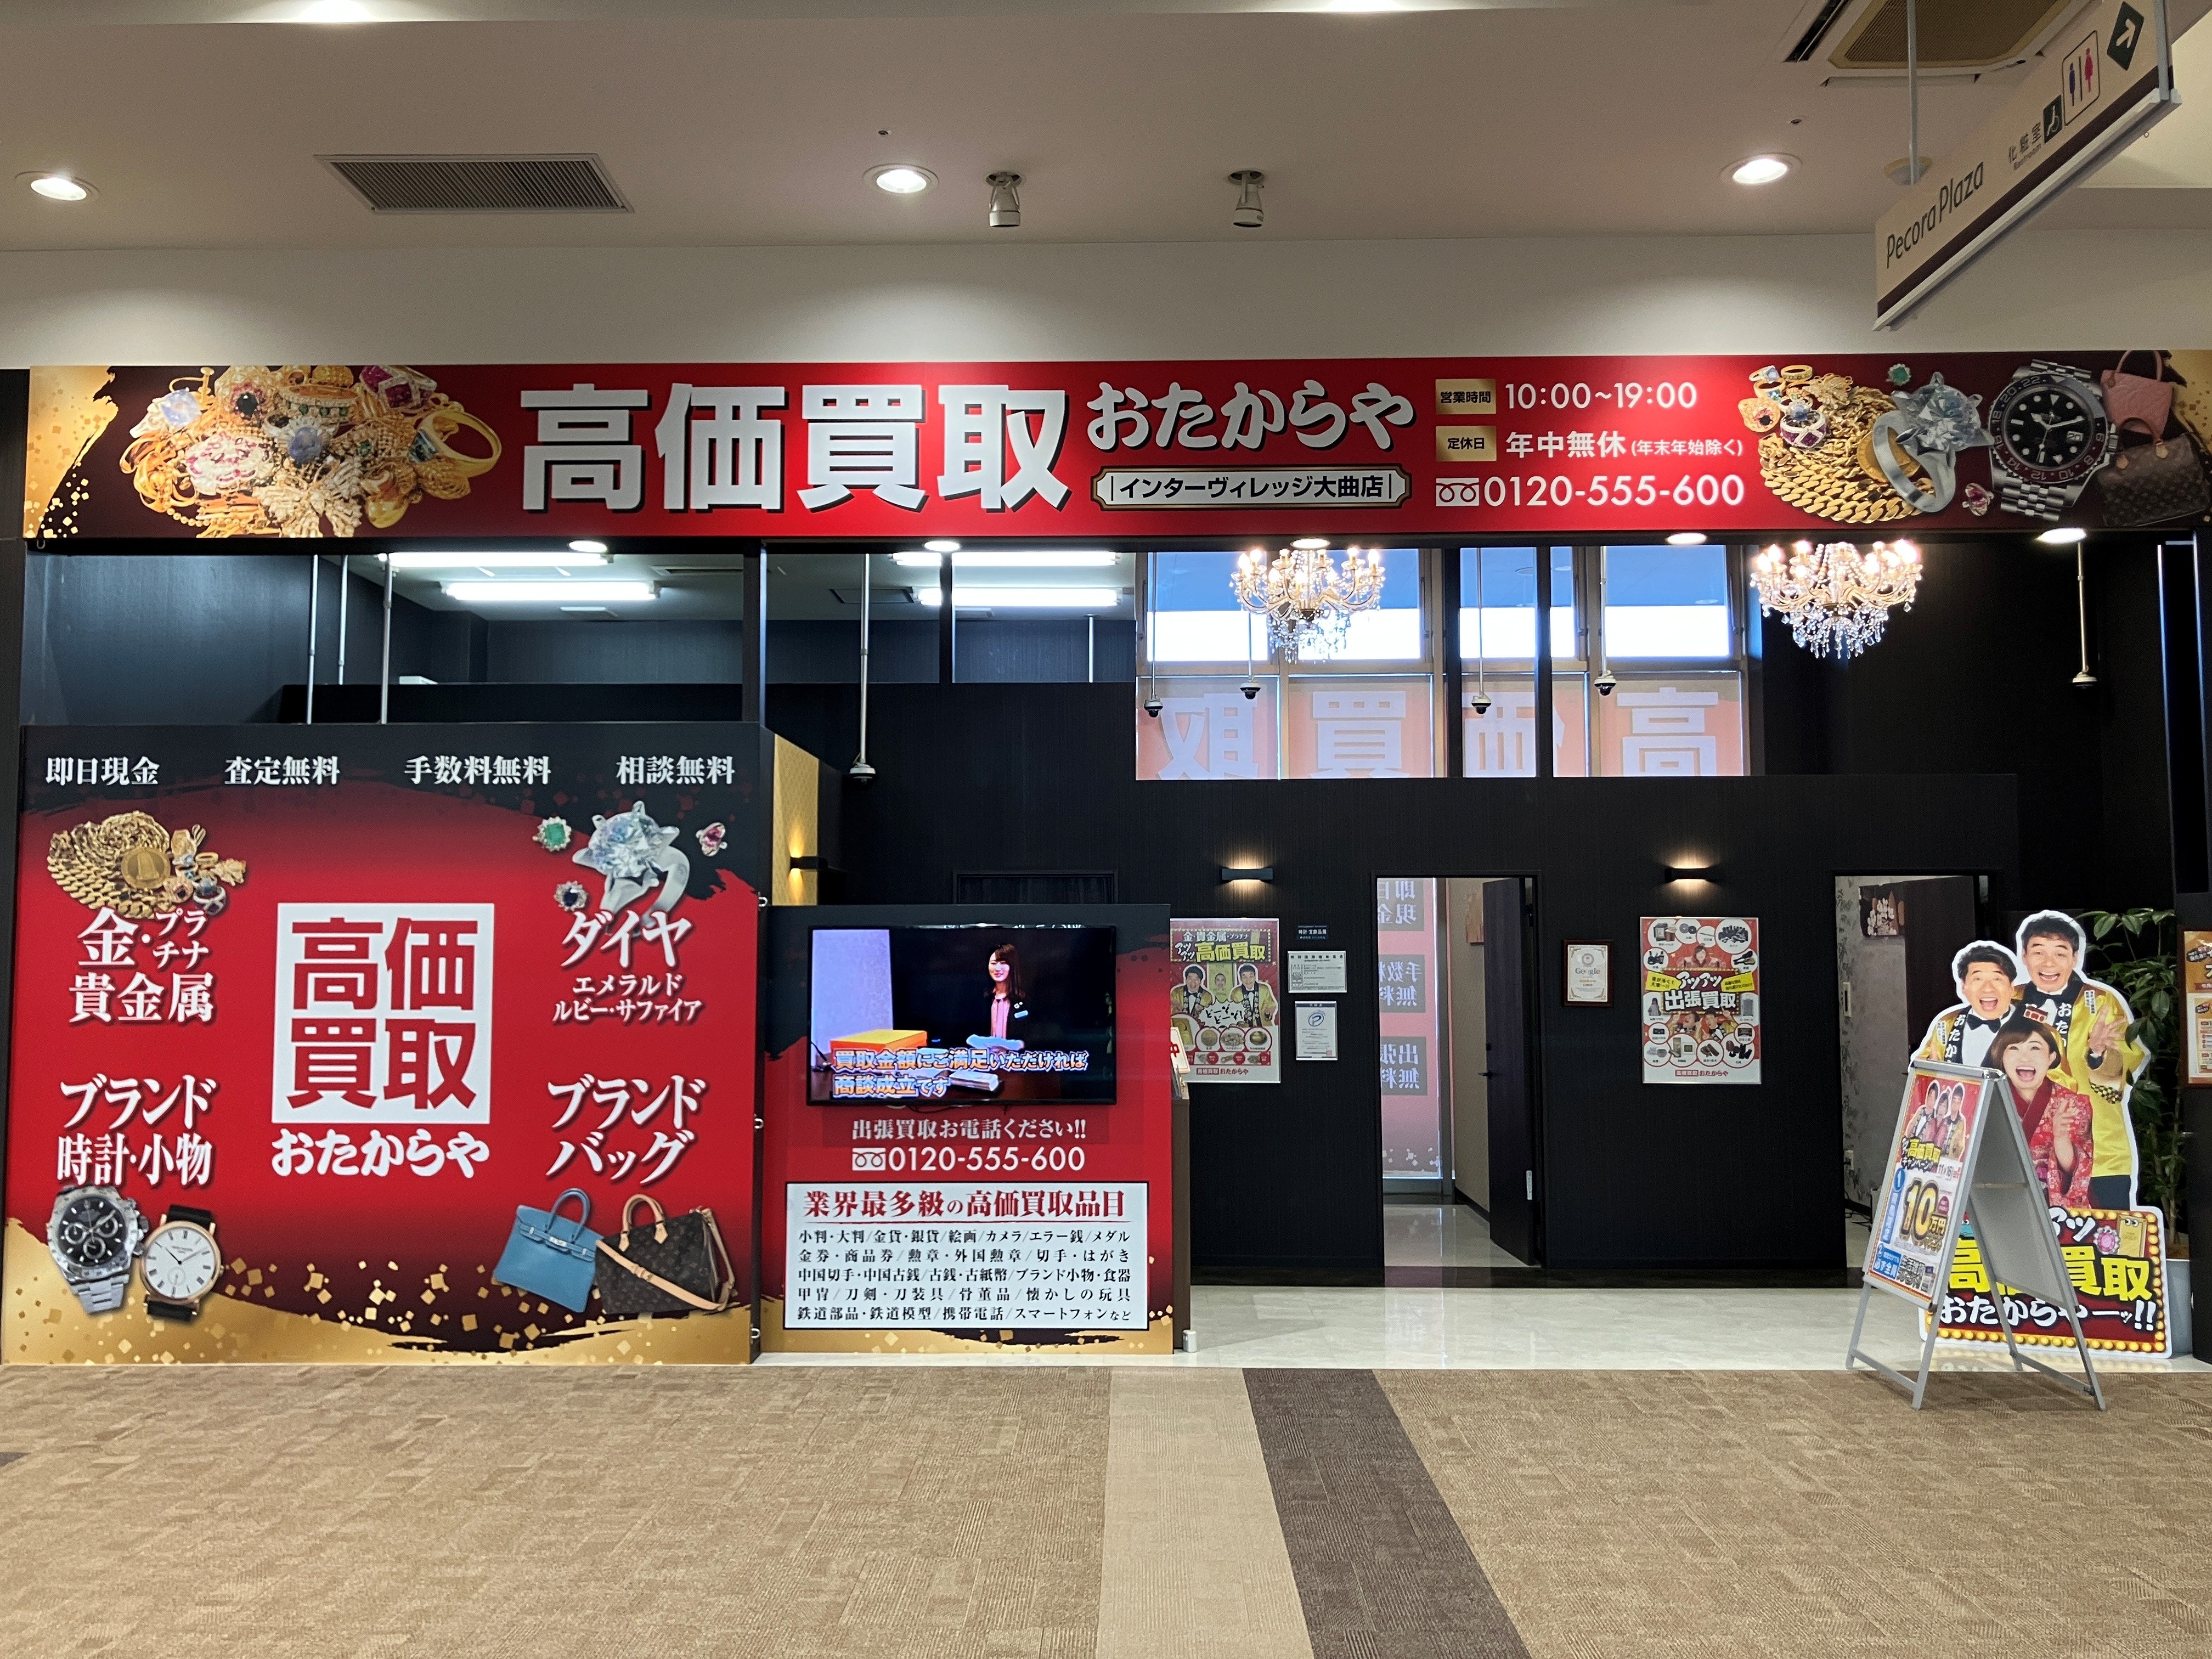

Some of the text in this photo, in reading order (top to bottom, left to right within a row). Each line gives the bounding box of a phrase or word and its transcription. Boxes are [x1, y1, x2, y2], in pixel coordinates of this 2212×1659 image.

[1886, 162, 1984, 269] Pecora Plaza
[1440, 391, 1491, 404] 営業時間
[1087, 380, 1414, 450] おたからや
[521, 383, 1070, 511] 高価買取
[1447, 437, 1486, 450] 定休日
[1505, 431, 1743, 459] 年中無休 (年末年始除く)
[1119, 475, 1383, 499] インターヴィレッジ大曲店
[1483, 474, 1745, 507] 0120-555-600
[45, 755, 736, 786] 即日現金 査定無料 手数料無料 相談無料
[561, 909, 692, 968] ダイヤ
[1194, 941, 1266, 963] 高価買取
[292, 917, 478, 1011] 高価
[1575, 967, 1601, 977] Google
[573, 972, 683, 997] エメラルド
[1676, 971, 1723, 990] アツアツ
[69, 971, 213, 1023] 貴金属
[552, 997, 703, 1023] ルビー・サファイア
[1664, 989, 1736, 1011] 出張買取
[286, 1018, 477, 1110] 買取
[833, 1048, 1088, 1070] 買取金額にご満足いただければ
[833, 1074, 950, 1096] 商談成立です
[60, 1073, 217, 1130] ブランド
[548, 1073, 706, 1129] ブランド
[851, 1119, 1086, 1140] 出張買取お電話ください!!
[57, 1132, 212, 1186] 時計・小物
[271, 1128, 490, 1178] おたからや
[545, 1129, 695, 1184] バッグ
[888, 1146, 1086, 1171] 0120-555-600
[804, 1189, 1125, 1218] 業界最多級の高価買取品目
[1948, 1238, 2152, 1301] 高買取
